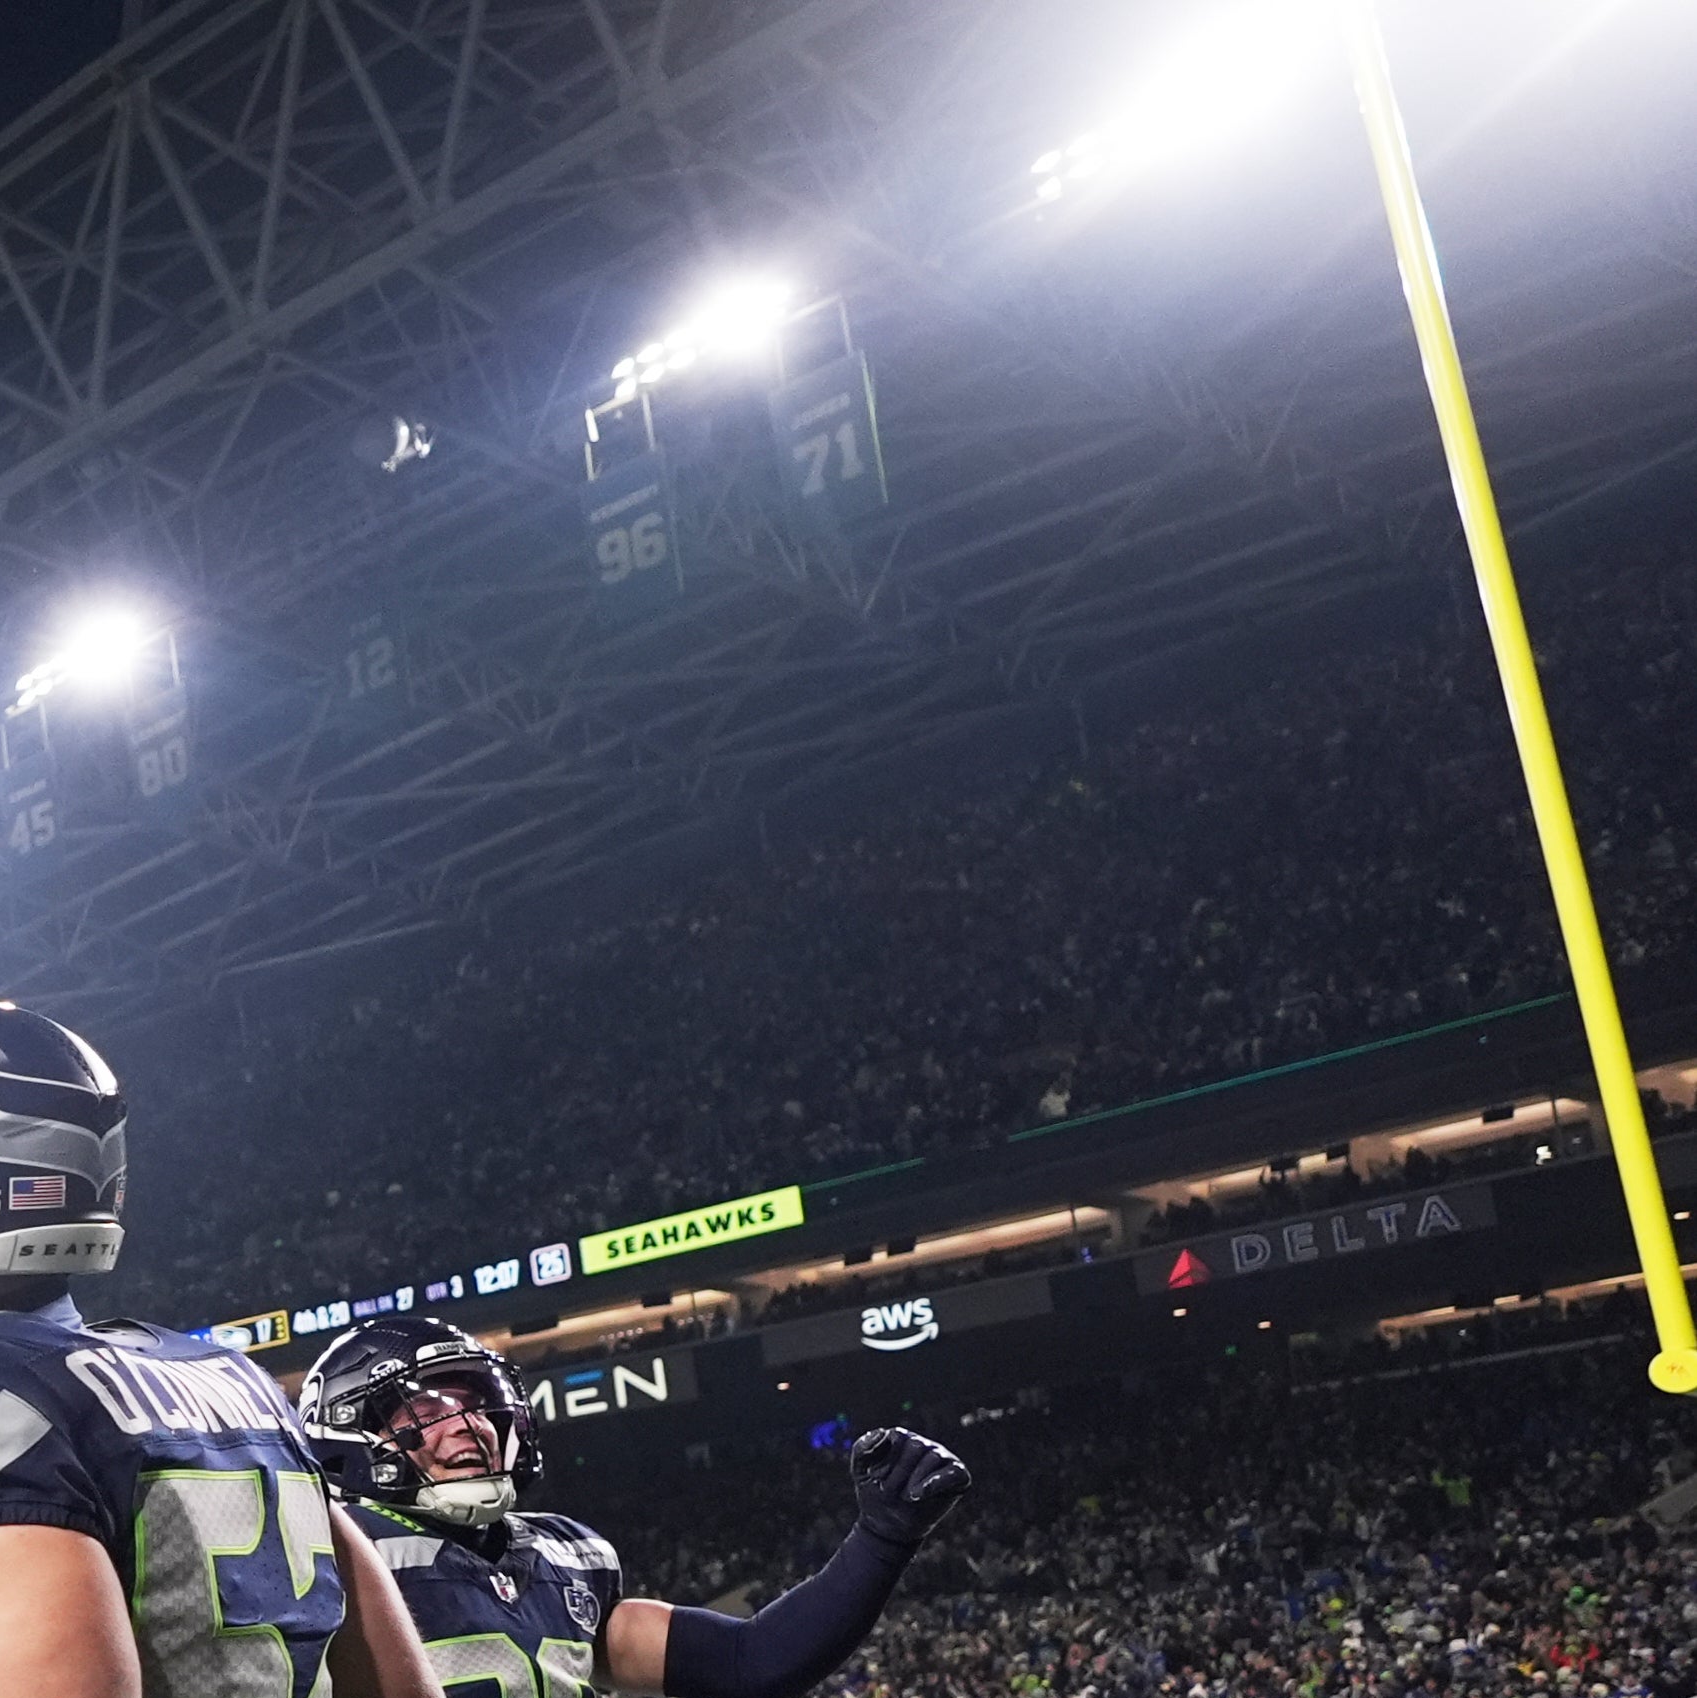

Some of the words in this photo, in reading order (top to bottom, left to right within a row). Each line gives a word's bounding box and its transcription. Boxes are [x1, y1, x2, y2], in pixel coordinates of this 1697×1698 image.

[791, 421, 864, 498] 71
[596, 511, 667, 585] 96
[344, 633, 398, 700] 12
[7, 797, 57, 856] 45
[606, 1201, 776, 1260] SEAHAWKS
[1232, 1194, 1464, 1275] DELTA
[395, 1286, 414, 1312] 27
[450, 1275, 464, 1300] 3
[474, 1258, 520, 1296] 12:07
[537, 1249, 566, 1279] 25
[861, 1298, 934, 1335] aws
